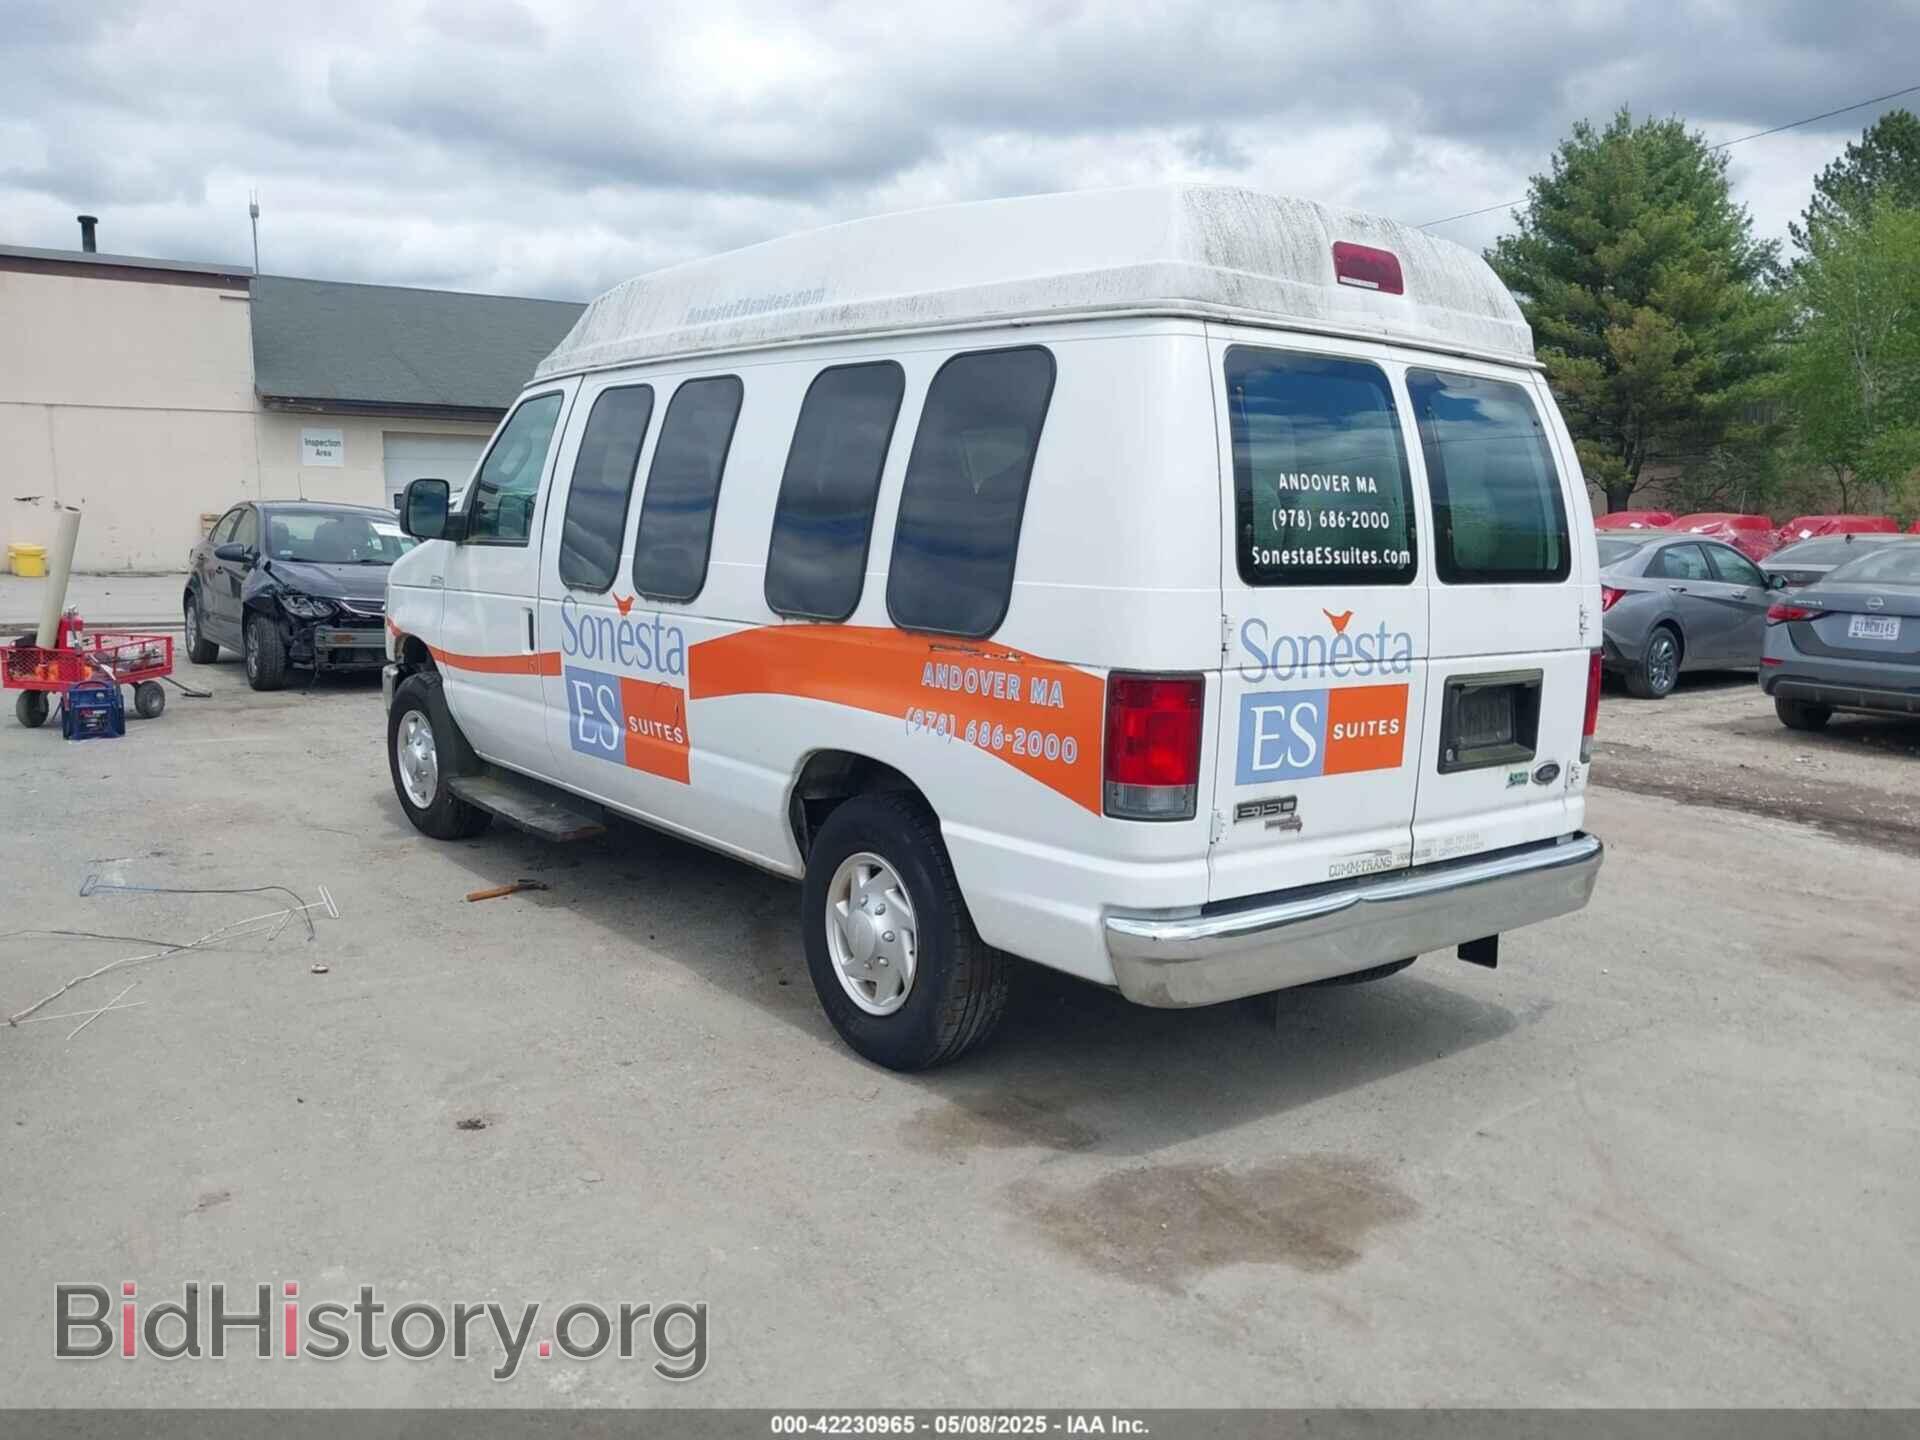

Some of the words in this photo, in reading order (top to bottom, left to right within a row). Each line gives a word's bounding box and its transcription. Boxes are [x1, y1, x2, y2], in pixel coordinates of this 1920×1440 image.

[304, 437, 342, 448] Inspection
[315, 448, 332, 457] Area
[1279, 473, 1350, 493] ANDOVER
[1356, 476, 1378, 494] MA
[1272, 509, 1312, 531] (978)
[1319, 511, 1390, 530] 686-2000
[1252, 546, 1411, 565] SonestaESsuites.com
[561, 594, 685, 676] Sonesta
[1240, 617, 1413, 684] Sonesta
[921, 661, 1021, 701] ANDOVER
[1029, 676, 1065, 709] MA
[572, 679, 620, 751] ES
[627, 715, 684, 744] SUITES
[905, 706, 956, 744] (978)
[965, 719, 1078, 765] 686-2000
[1251, 702, 1318, 771] ES
[1333, 718, 1400, 740] SUITES
